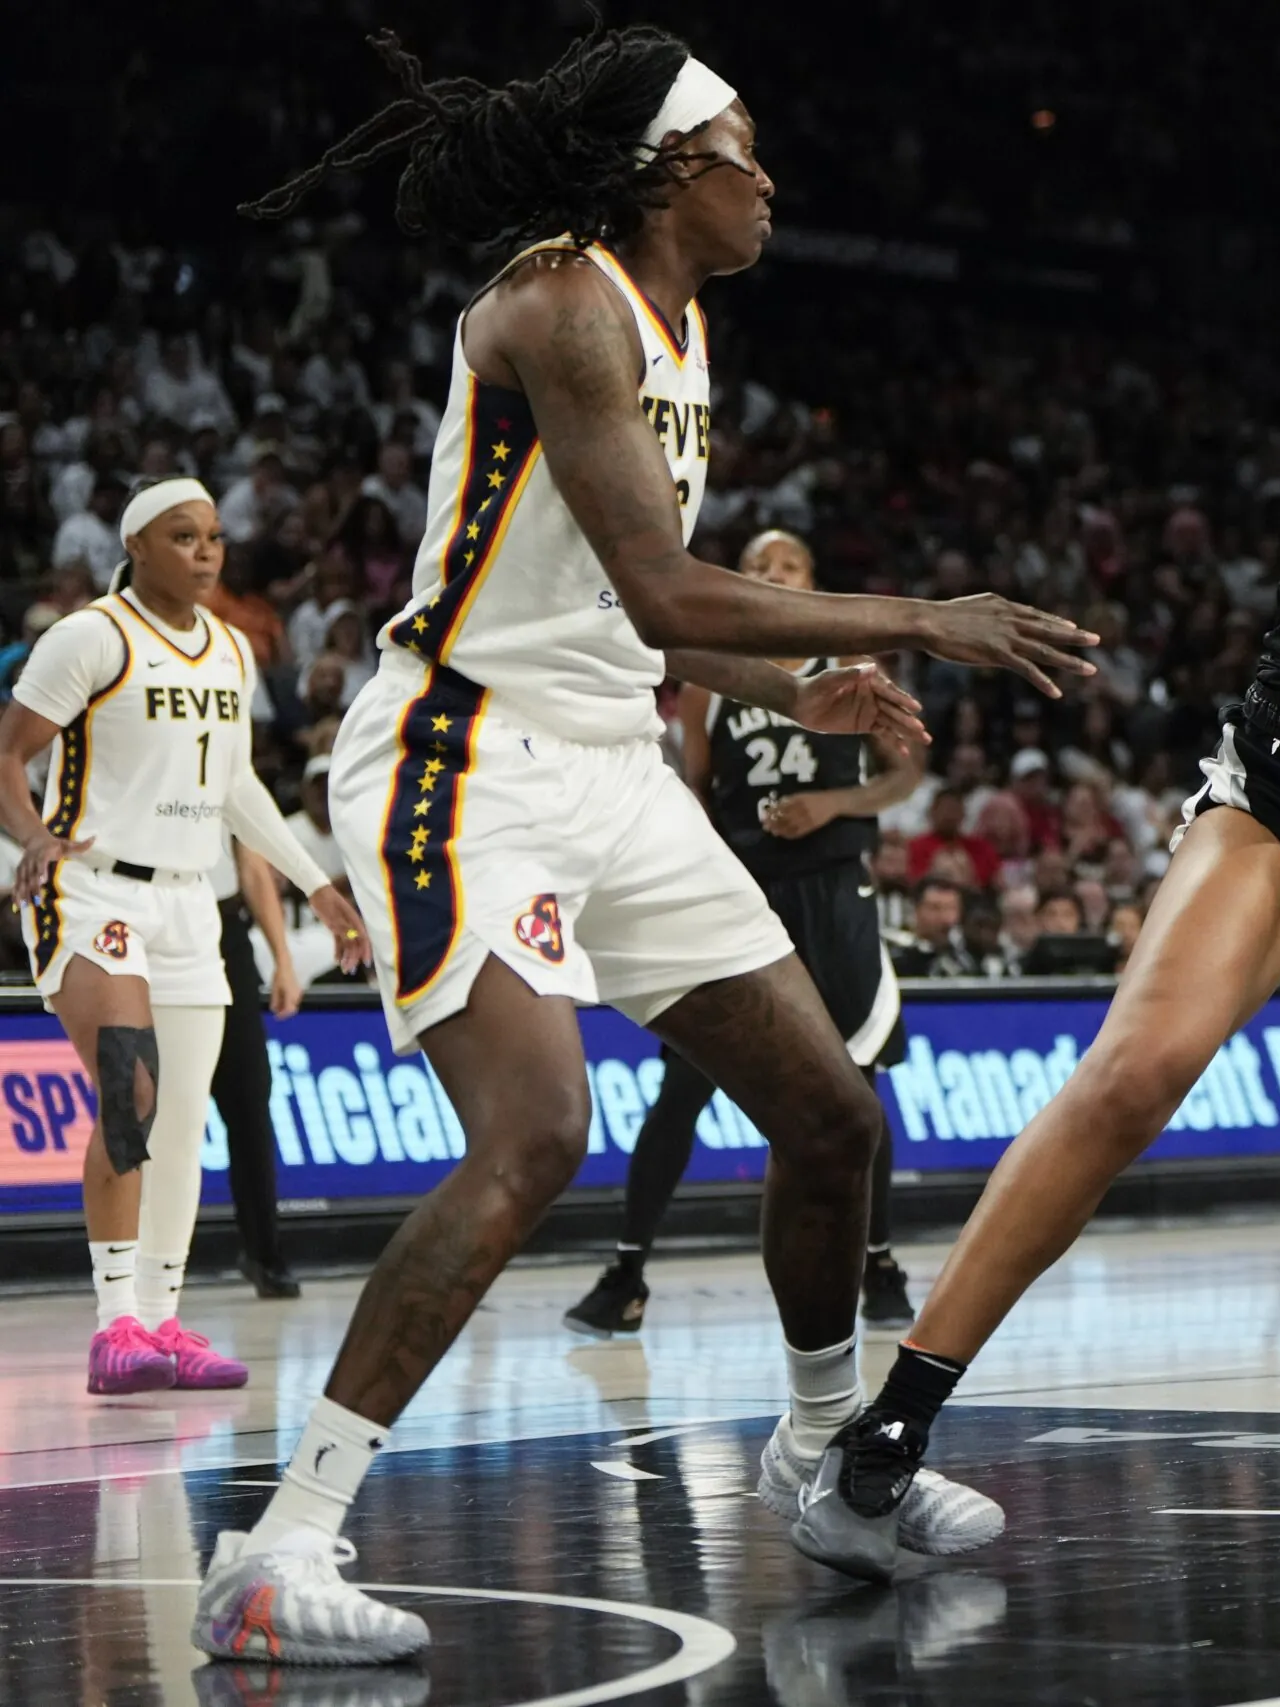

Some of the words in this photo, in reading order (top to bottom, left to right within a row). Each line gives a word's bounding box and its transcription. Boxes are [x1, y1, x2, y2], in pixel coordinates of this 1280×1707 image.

[145, 686, 239, 723] FEVER
[196, 730, 211, 787] 1
[744, 734, 819, 787] 24
[154, 799, 223, 824] salesfor
